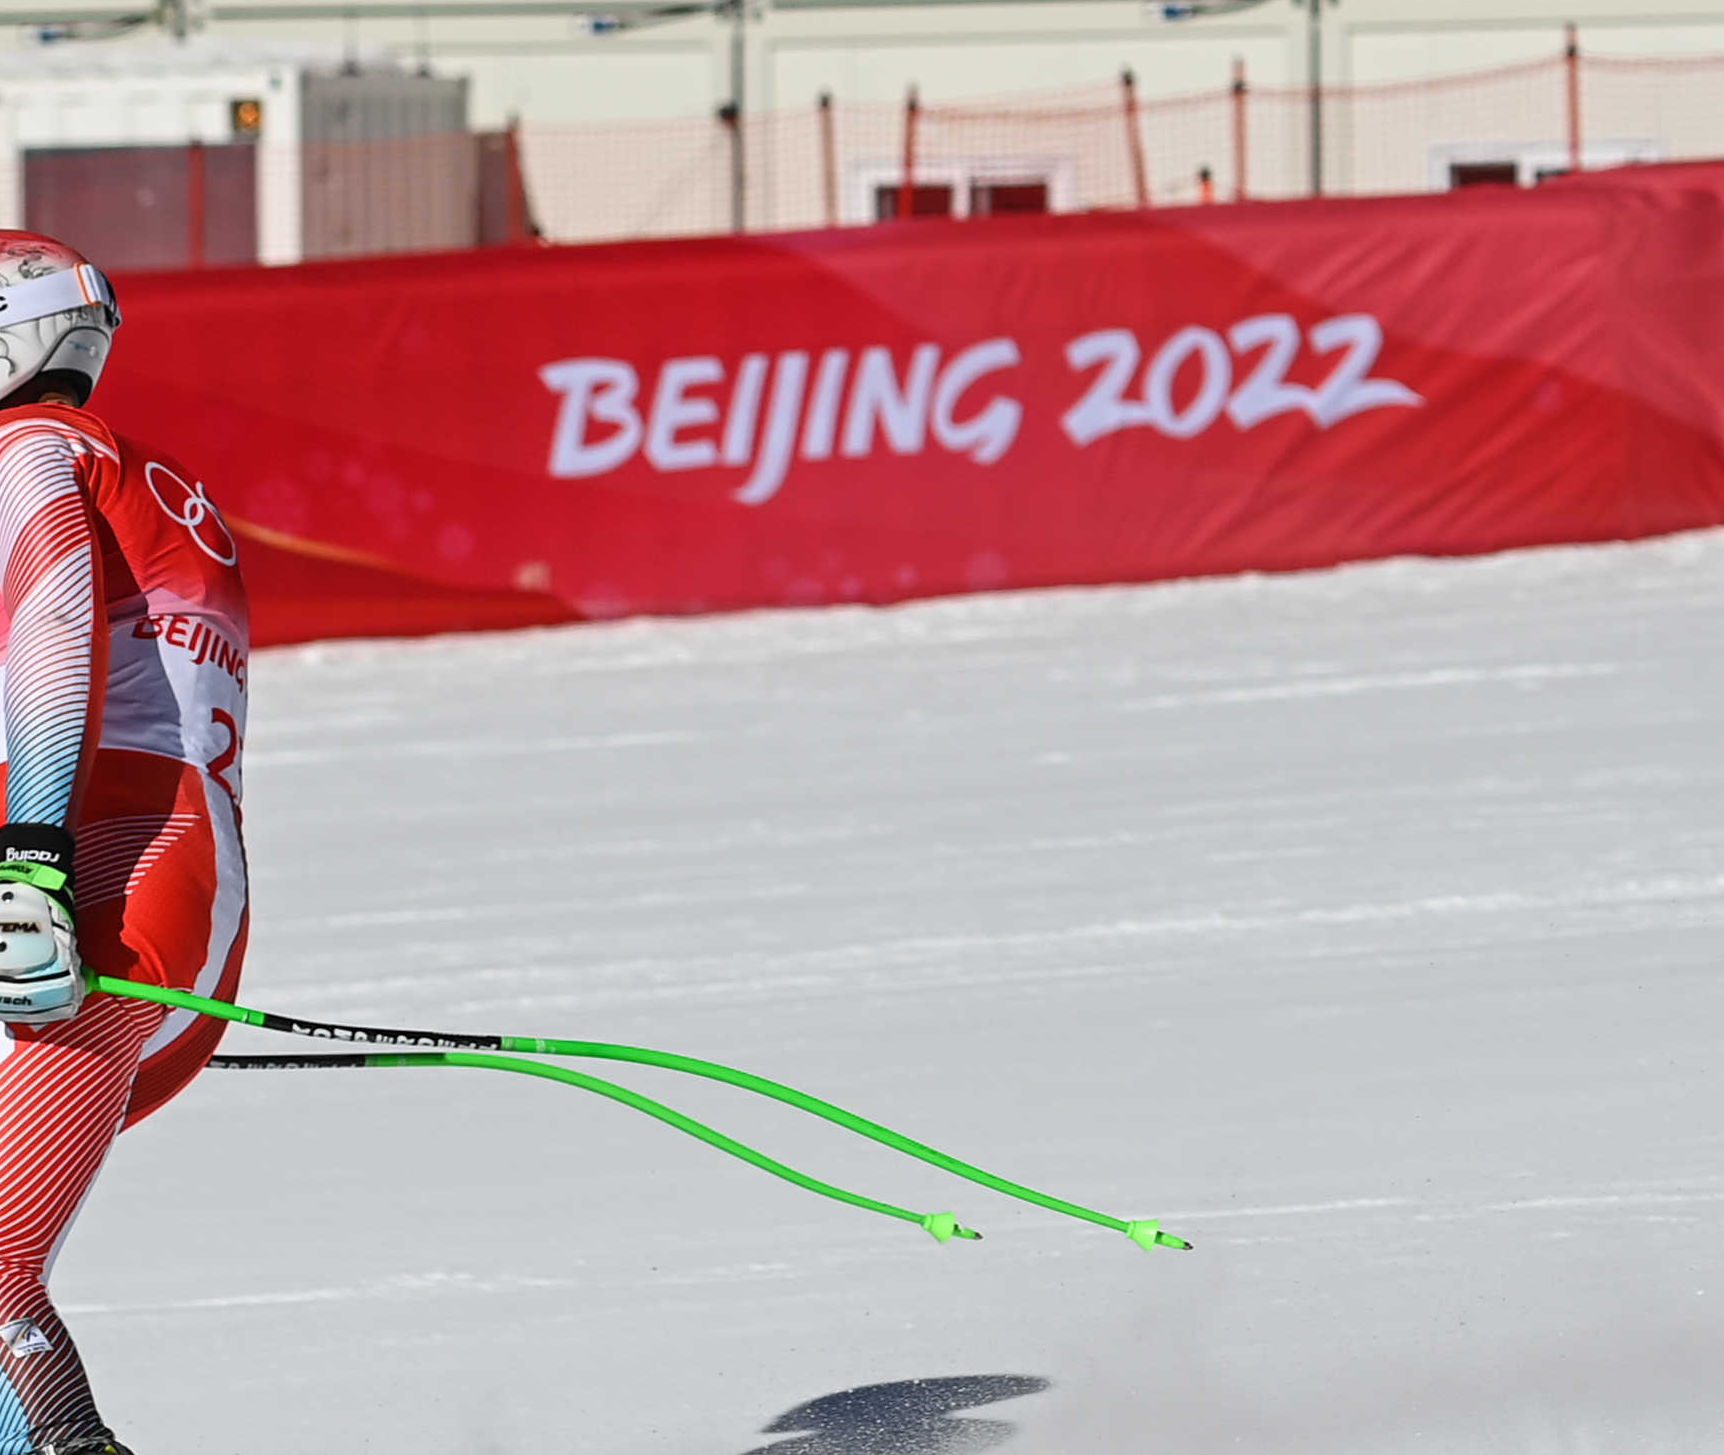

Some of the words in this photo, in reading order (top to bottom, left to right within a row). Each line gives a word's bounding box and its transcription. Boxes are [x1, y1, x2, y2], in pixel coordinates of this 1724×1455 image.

[541, 339, 1021, 504] BEIJING
[1062, 314, 1420, 445] 2022
[206, 707, 243, 800] 2
